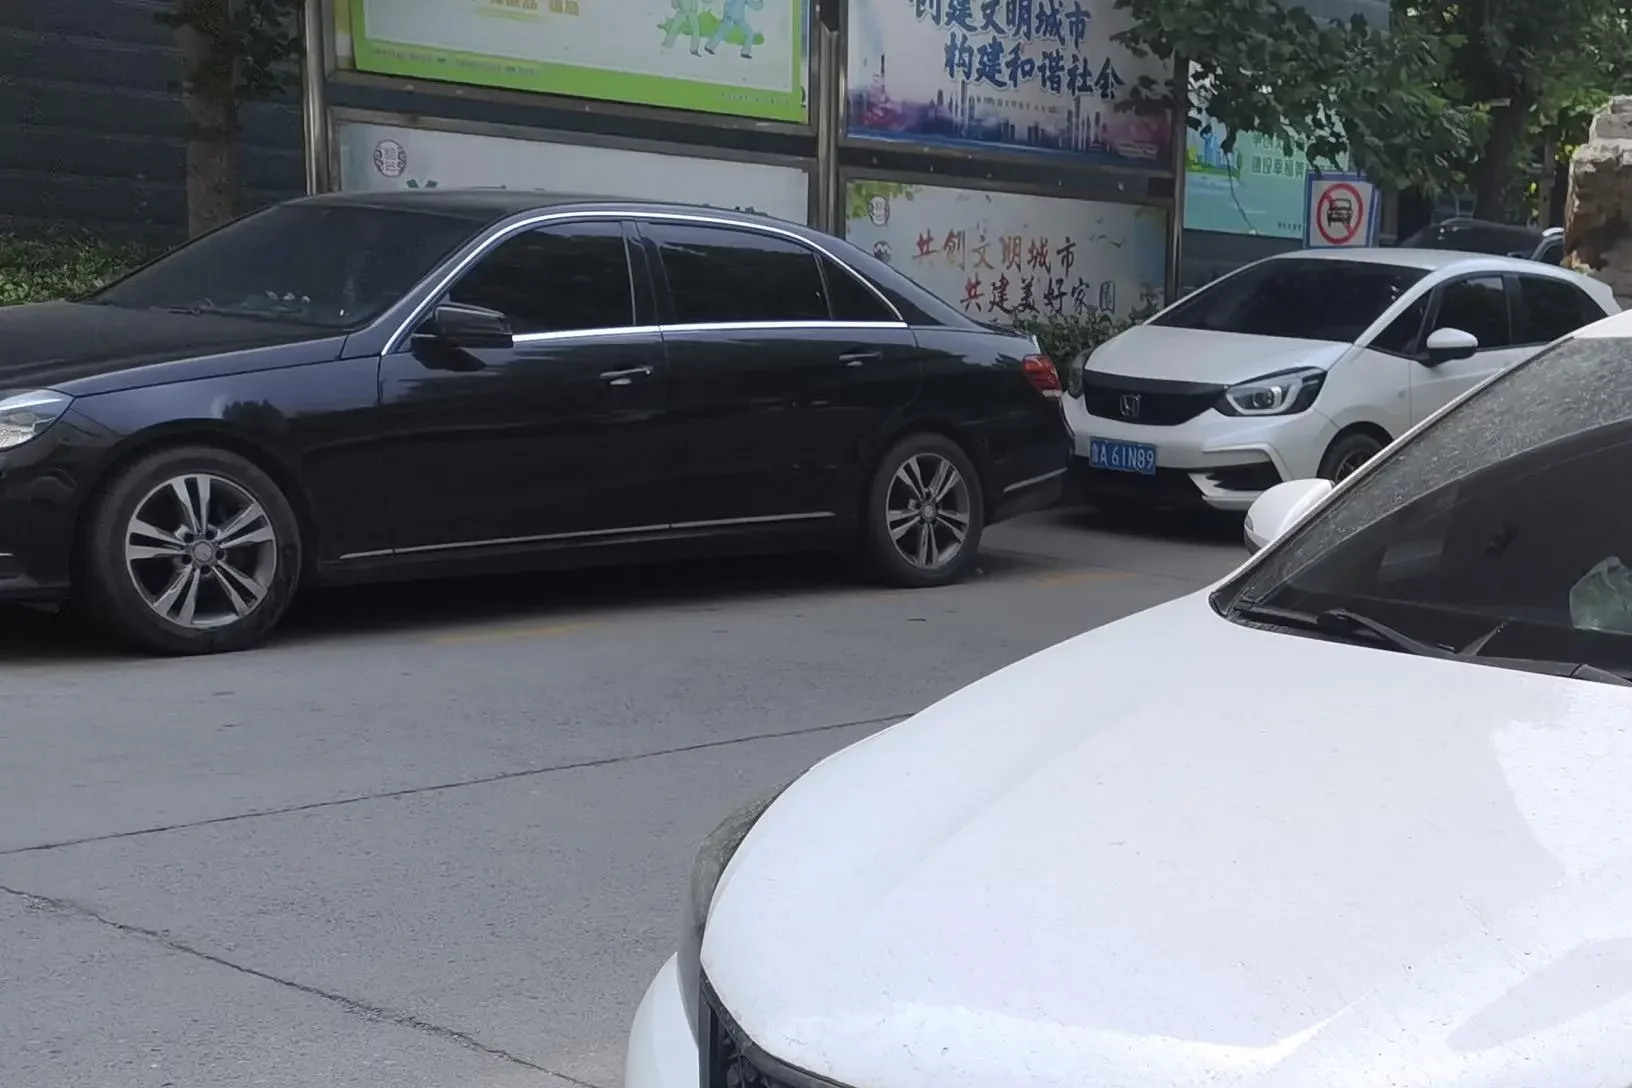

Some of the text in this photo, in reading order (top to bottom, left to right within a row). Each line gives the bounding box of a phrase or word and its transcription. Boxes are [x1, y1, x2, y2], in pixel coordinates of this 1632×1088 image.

[944, 31, 1126, 100] 构建和谐社会
[912, 228, 1077, 278] 共创文明城市
